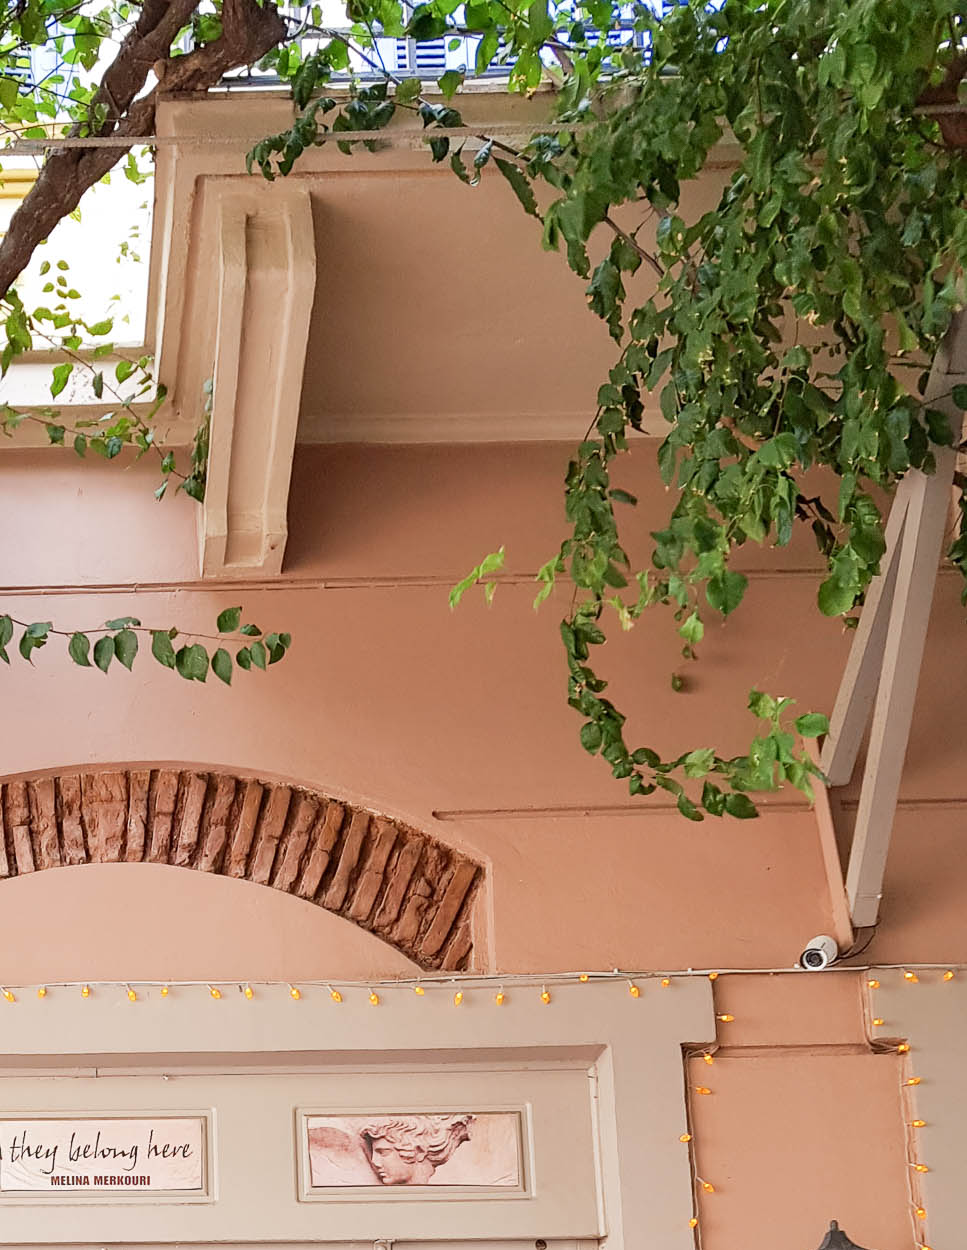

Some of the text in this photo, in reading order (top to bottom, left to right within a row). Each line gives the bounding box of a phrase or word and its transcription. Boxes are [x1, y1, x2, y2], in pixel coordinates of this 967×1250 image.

[9, 1129, 193, 1175] they belong here
[50, 1175, 151, 1186] MELINA MERKOURI
